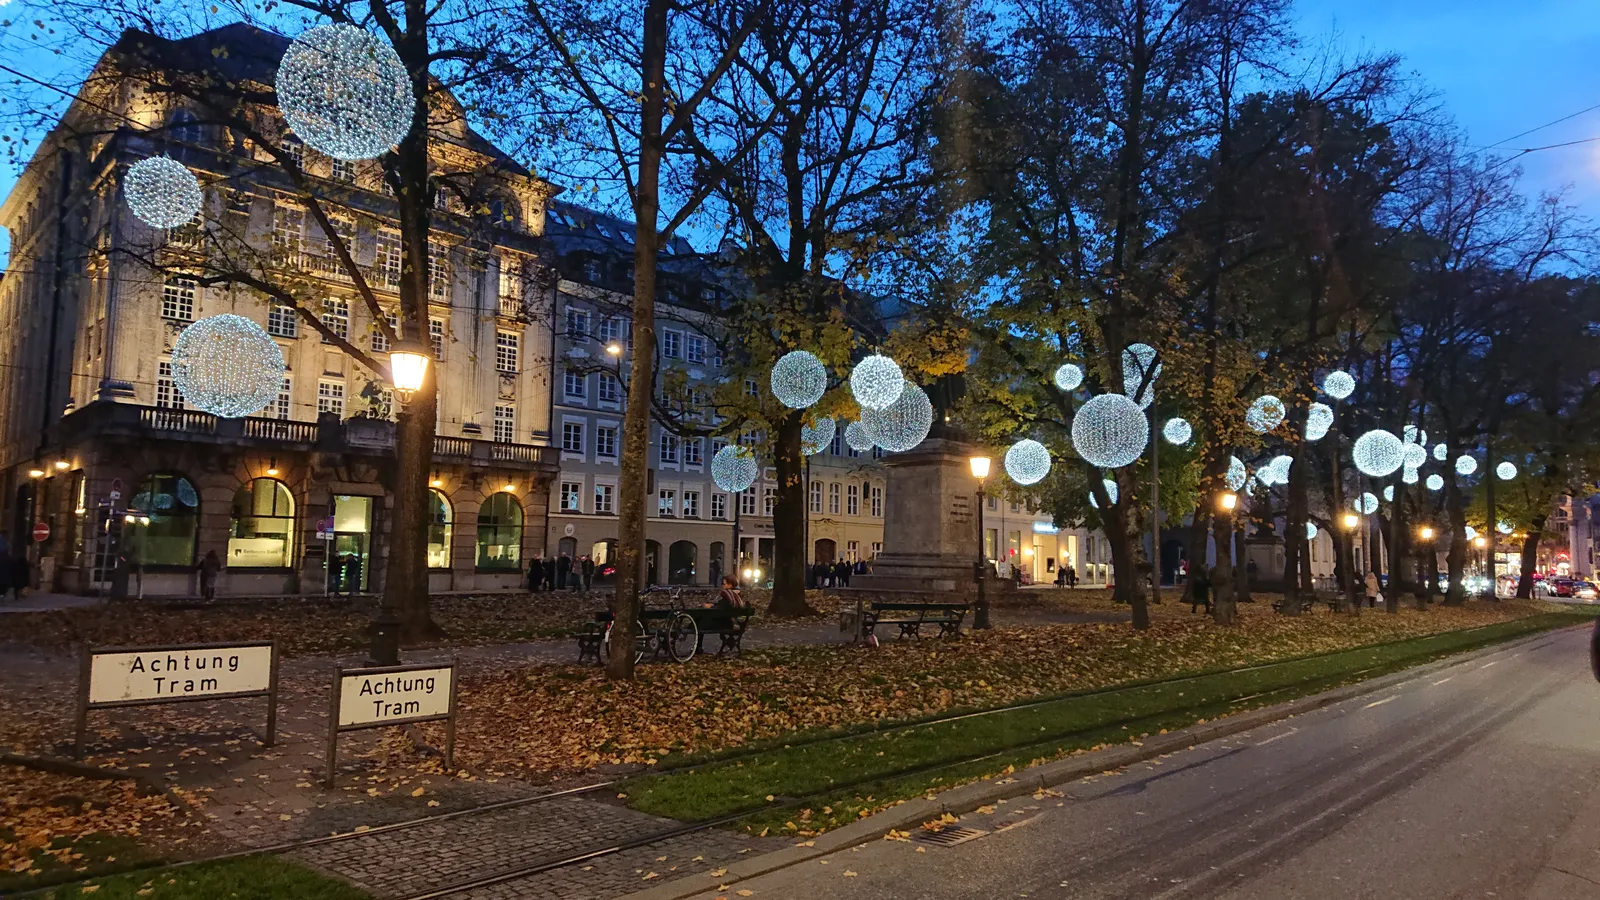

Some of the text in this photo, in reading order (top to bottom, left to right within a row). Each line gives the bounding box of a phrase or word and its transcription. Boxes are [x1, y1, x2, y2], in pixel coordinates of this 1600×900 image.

[130, 655, 239, 674] Achtung
[153, 677, 218, 694] Tram
[359, 677, 435, 697] Achtung
[373, 700, 420, 718] Tram
